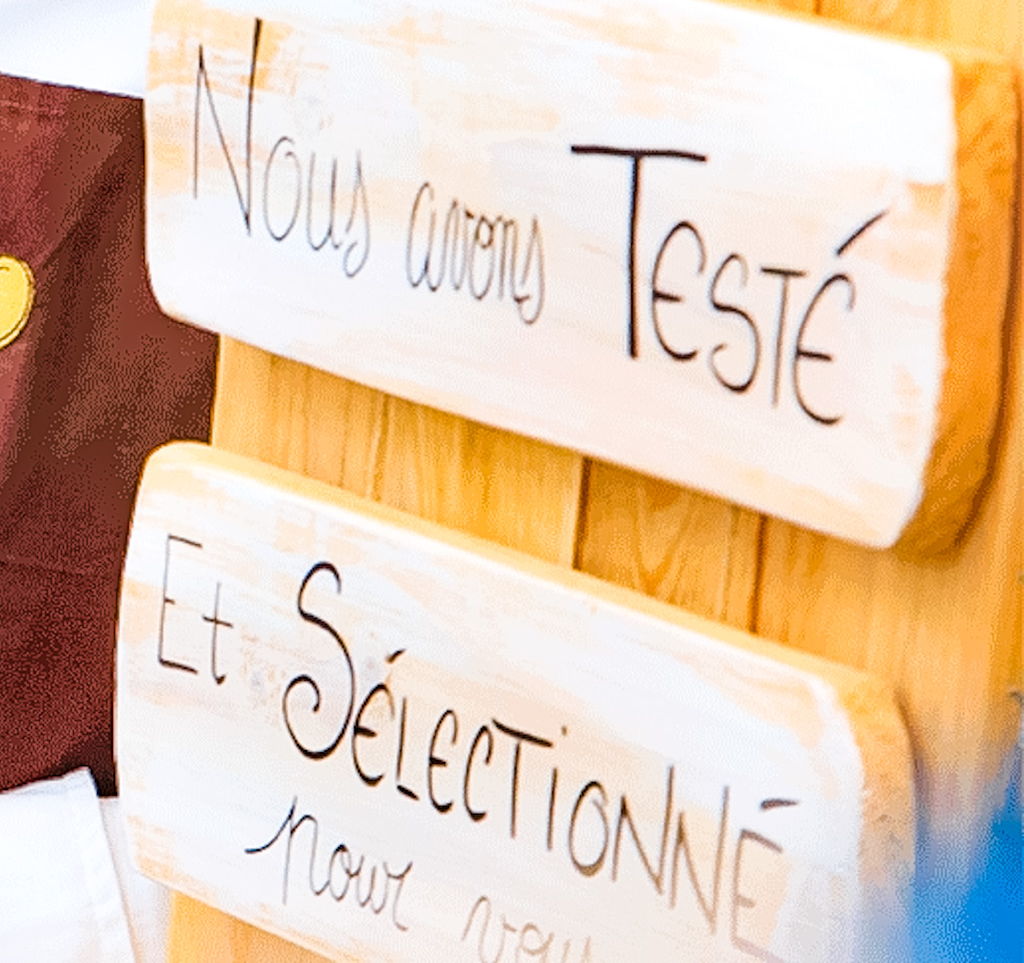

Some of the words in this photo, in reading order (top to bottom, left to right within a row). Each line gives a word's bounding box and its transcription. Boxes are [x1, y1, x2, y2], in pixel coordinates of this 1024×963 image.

[193, 17, 371, 278] Nous
[405, 182, 546, 326] avons
[157, 534, 235, 685] Et
